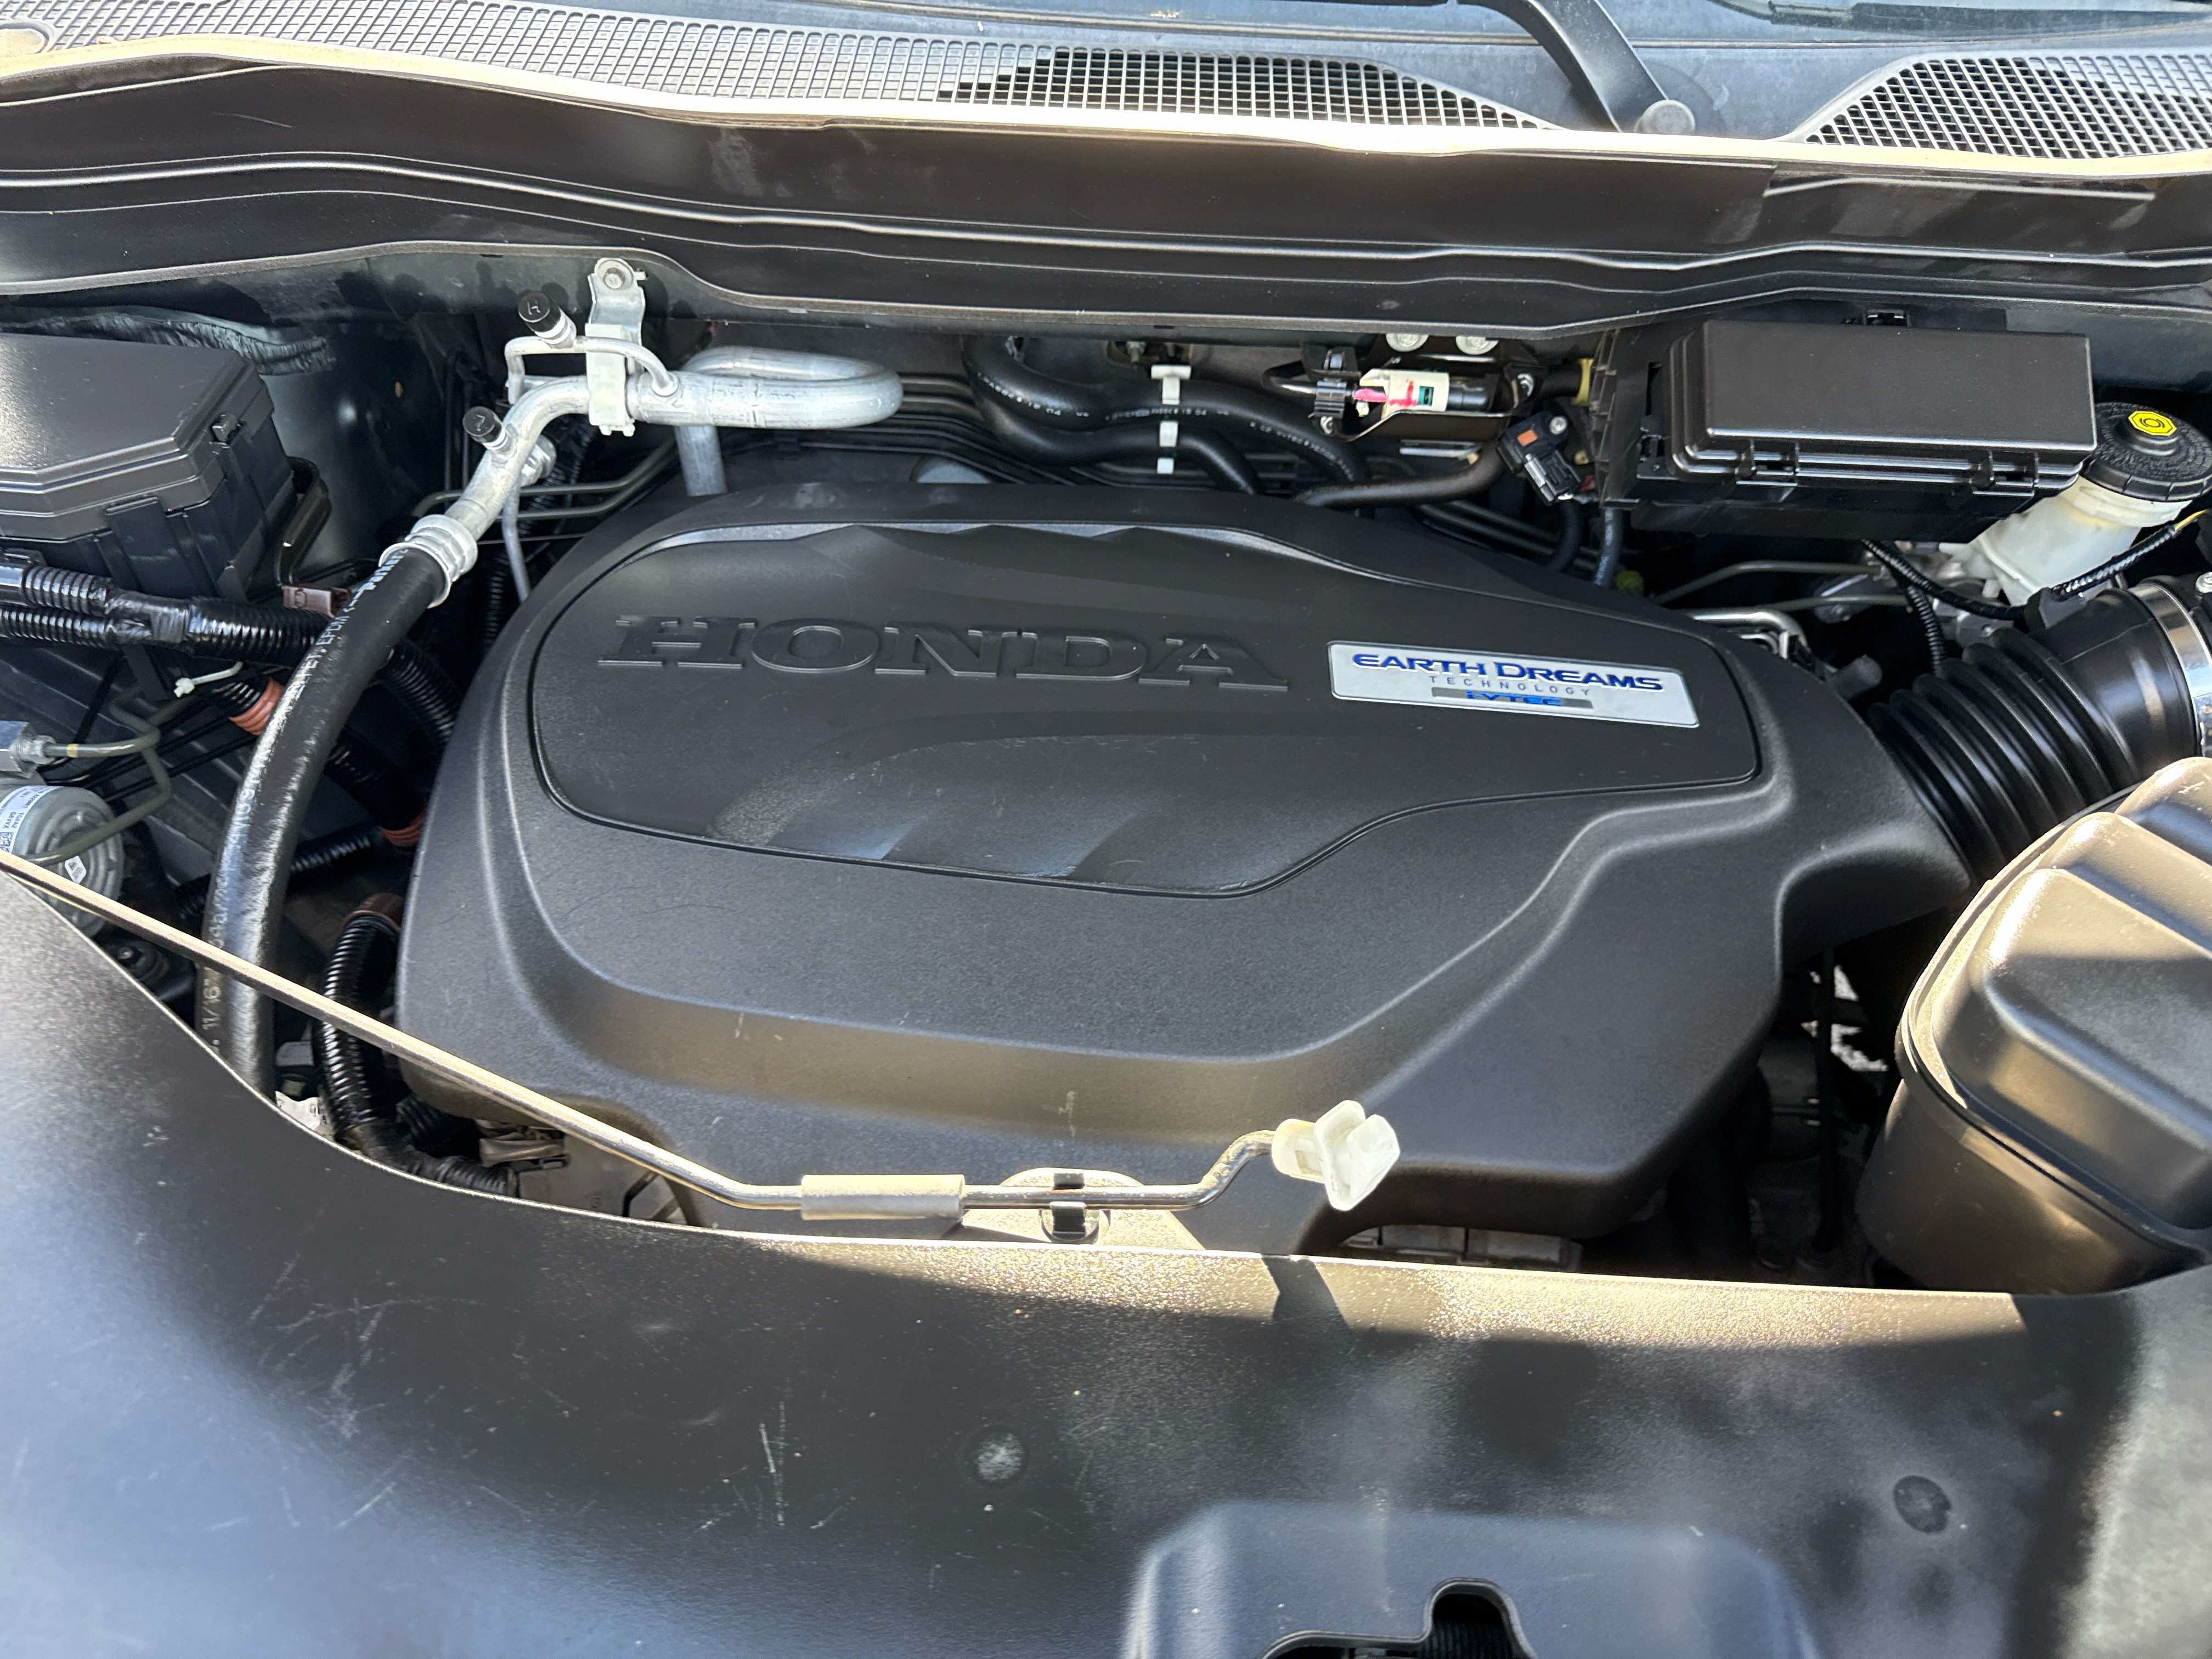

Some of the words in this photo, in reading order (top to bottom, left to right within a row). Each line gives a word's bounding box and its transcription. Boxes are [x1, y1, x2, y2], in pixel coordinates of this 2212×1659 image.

[597, 614, 1289, 692] HONDA
[1351, 653, 1488, 678] EARTH
[1493, 662, 1664, 692] DREAMS
[1429, 675, 1590, 696] TECHNOLOGY
